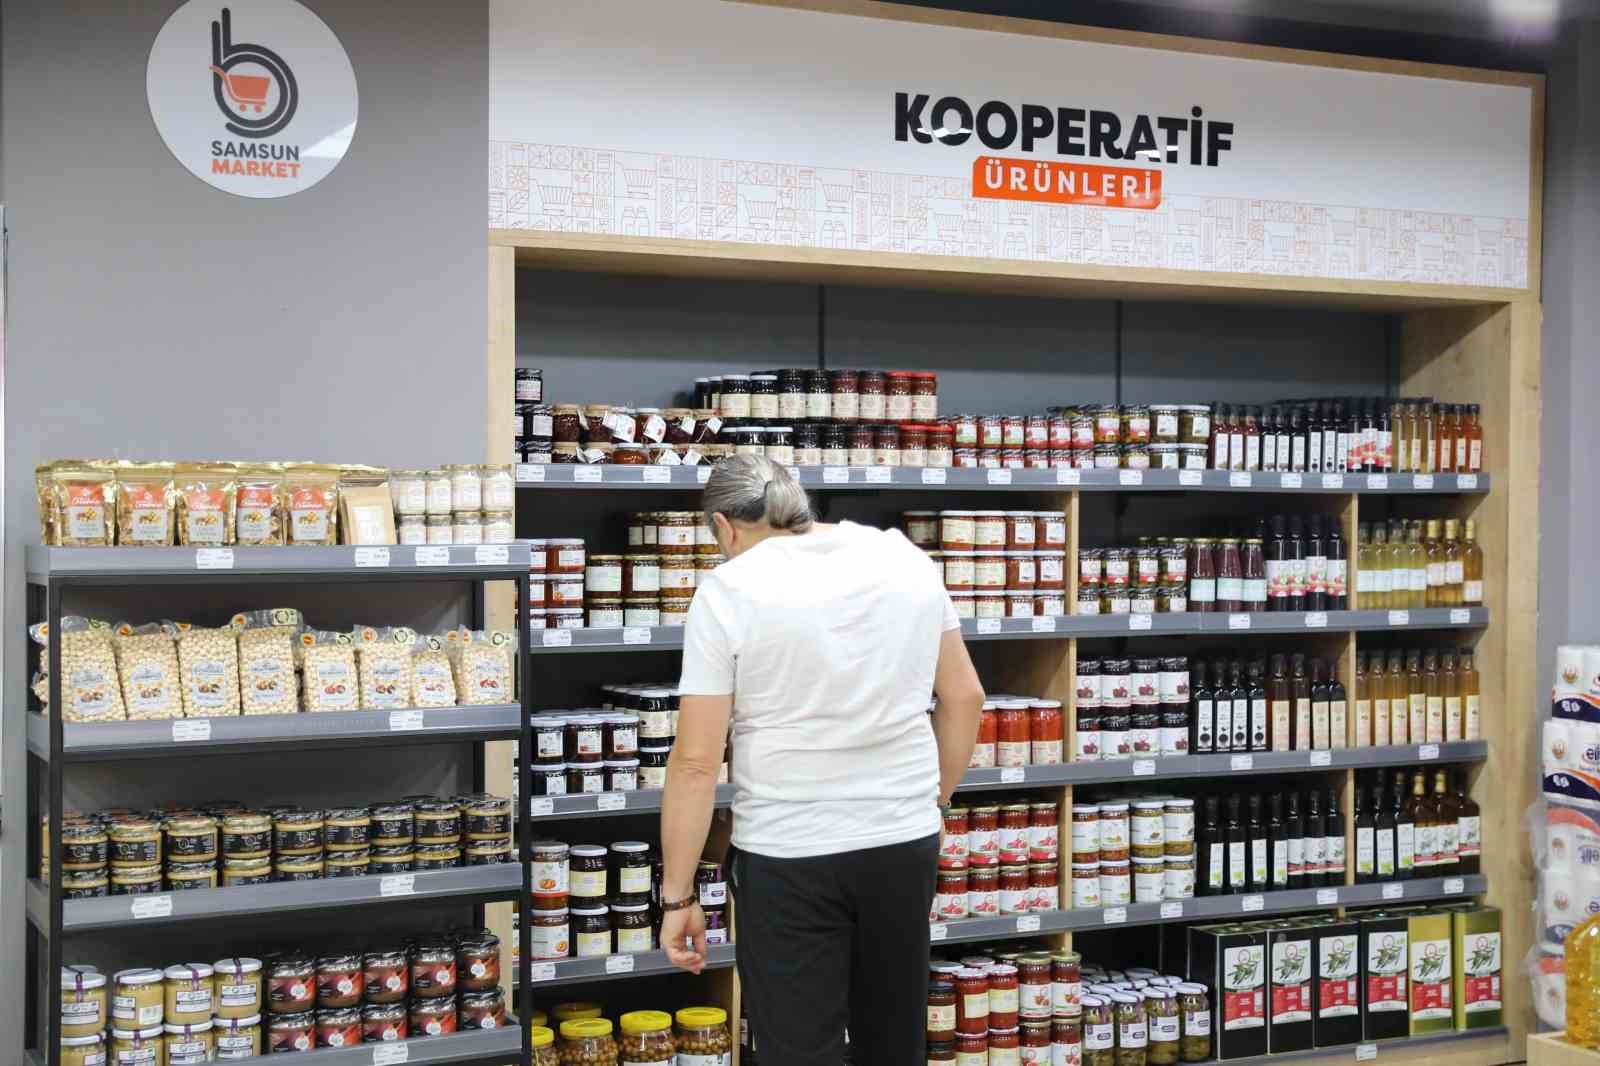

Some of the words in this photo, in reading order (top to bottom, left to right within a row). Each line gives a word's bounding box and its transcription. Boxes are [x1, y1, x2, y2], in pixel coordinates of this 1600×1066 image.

[894, 92, 1234, 167] KOOPERATİF
[211, 140, 300, 161] SAMSUN
[211, 159, 301, 179] MARKET
[984, 159, 1153, 199] ÜRÜNLERİ
